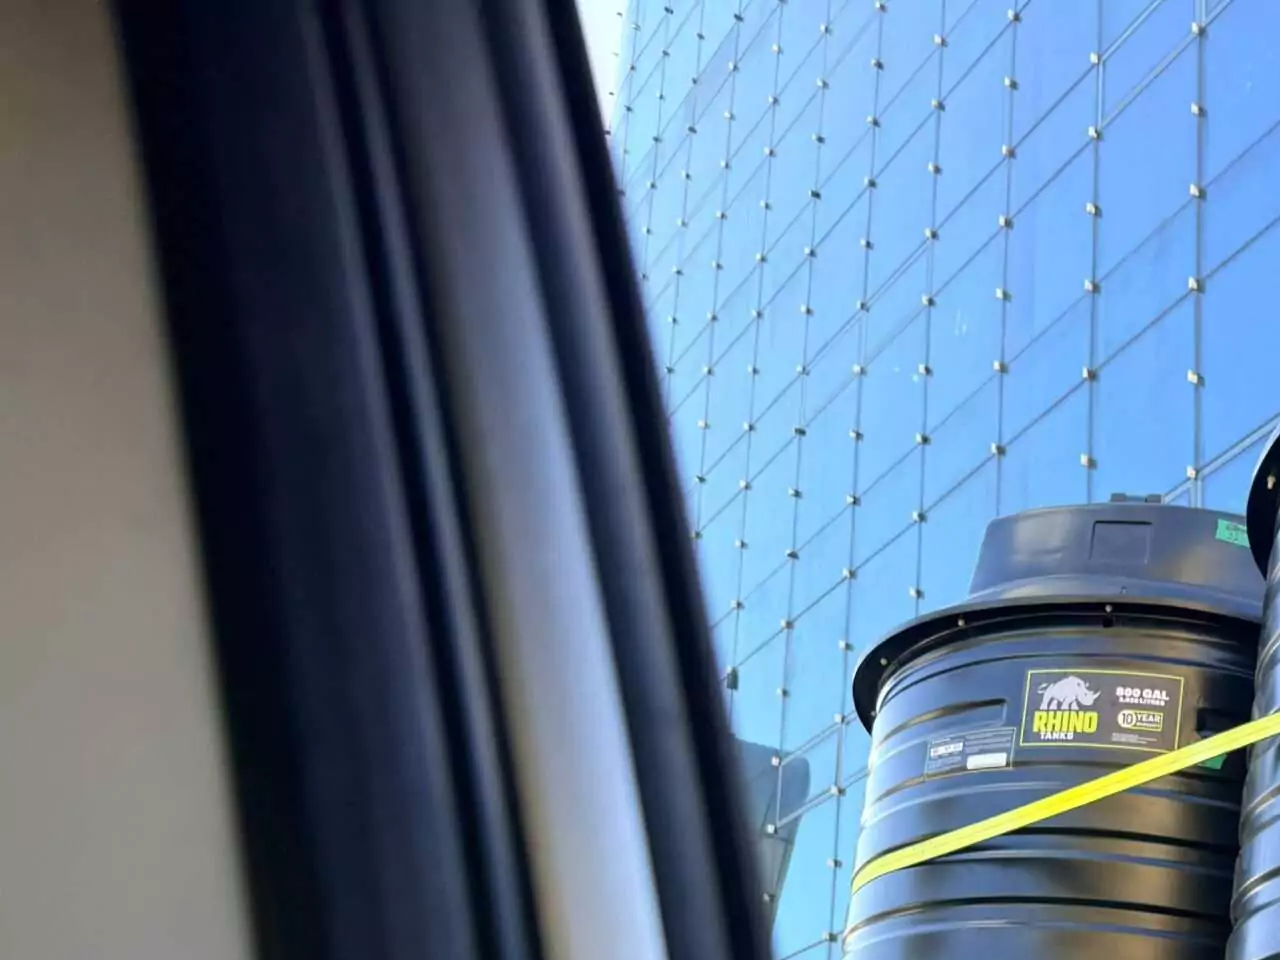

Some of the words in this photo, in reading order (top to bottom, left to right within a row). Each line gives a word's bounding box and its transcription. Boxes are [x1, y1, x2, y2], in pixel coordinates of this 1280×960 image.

[1115, 686, 1141, 698] 800
[1142, 688, 1170, 701] GAL
[1033, 710, 1099, 733] RHINO
[1121, 712, 1133, 725] 10
[1136, 714, 1161, 723] YEAR
